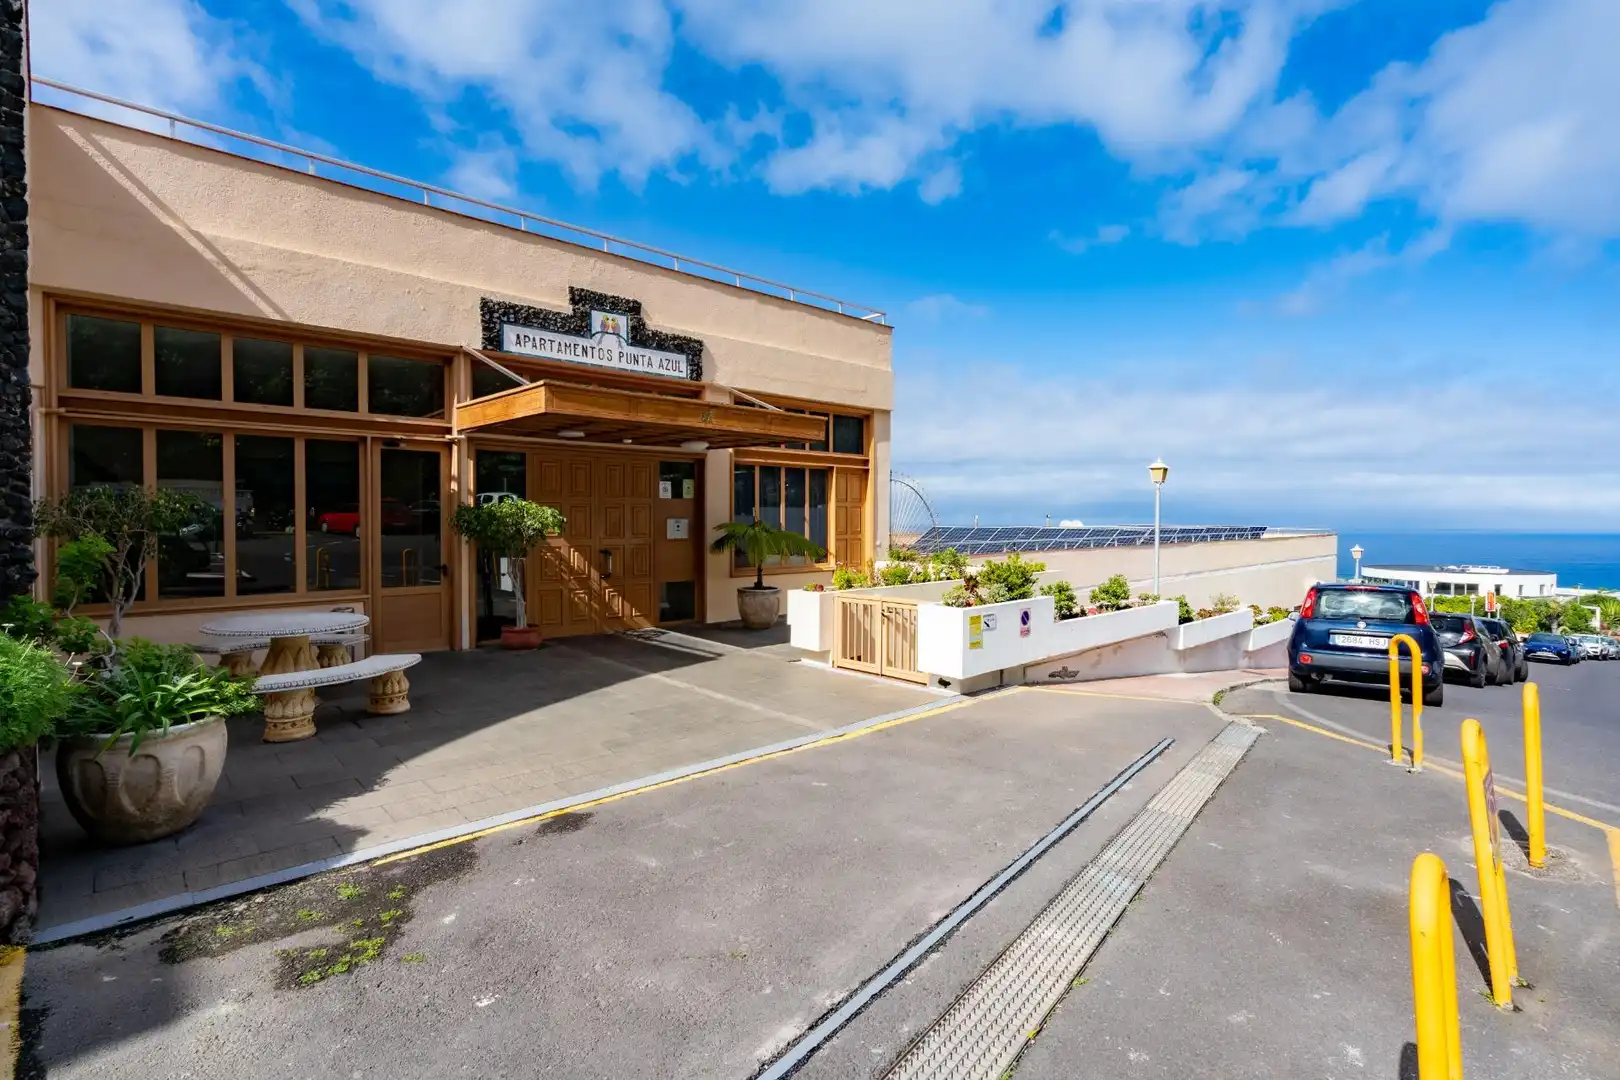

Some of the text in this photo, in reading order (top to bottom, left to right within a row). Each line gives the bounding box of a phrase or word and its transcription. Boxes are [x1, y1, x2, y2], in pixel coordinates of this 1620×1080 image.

[515, 333, 684, 373] APARTAMENTOS PUNTA AZUL
